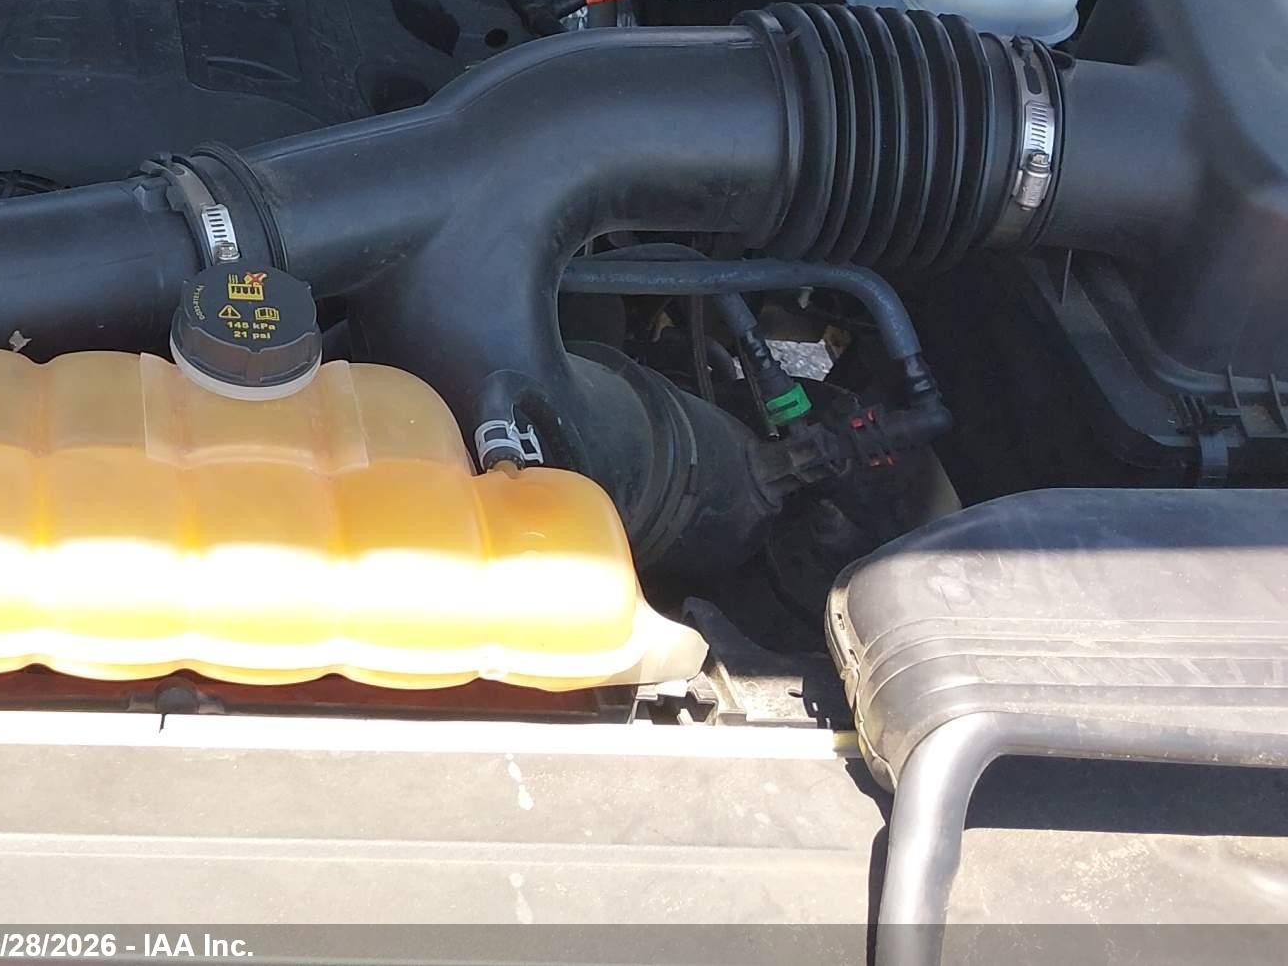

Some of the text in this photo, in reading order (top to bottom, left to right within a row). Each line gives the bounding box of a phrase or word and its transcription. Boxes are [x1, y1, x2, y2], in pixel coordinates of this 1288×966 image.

[226, 321, 276, 330] 145 kPa
[233, 330, 247, 338] 21
